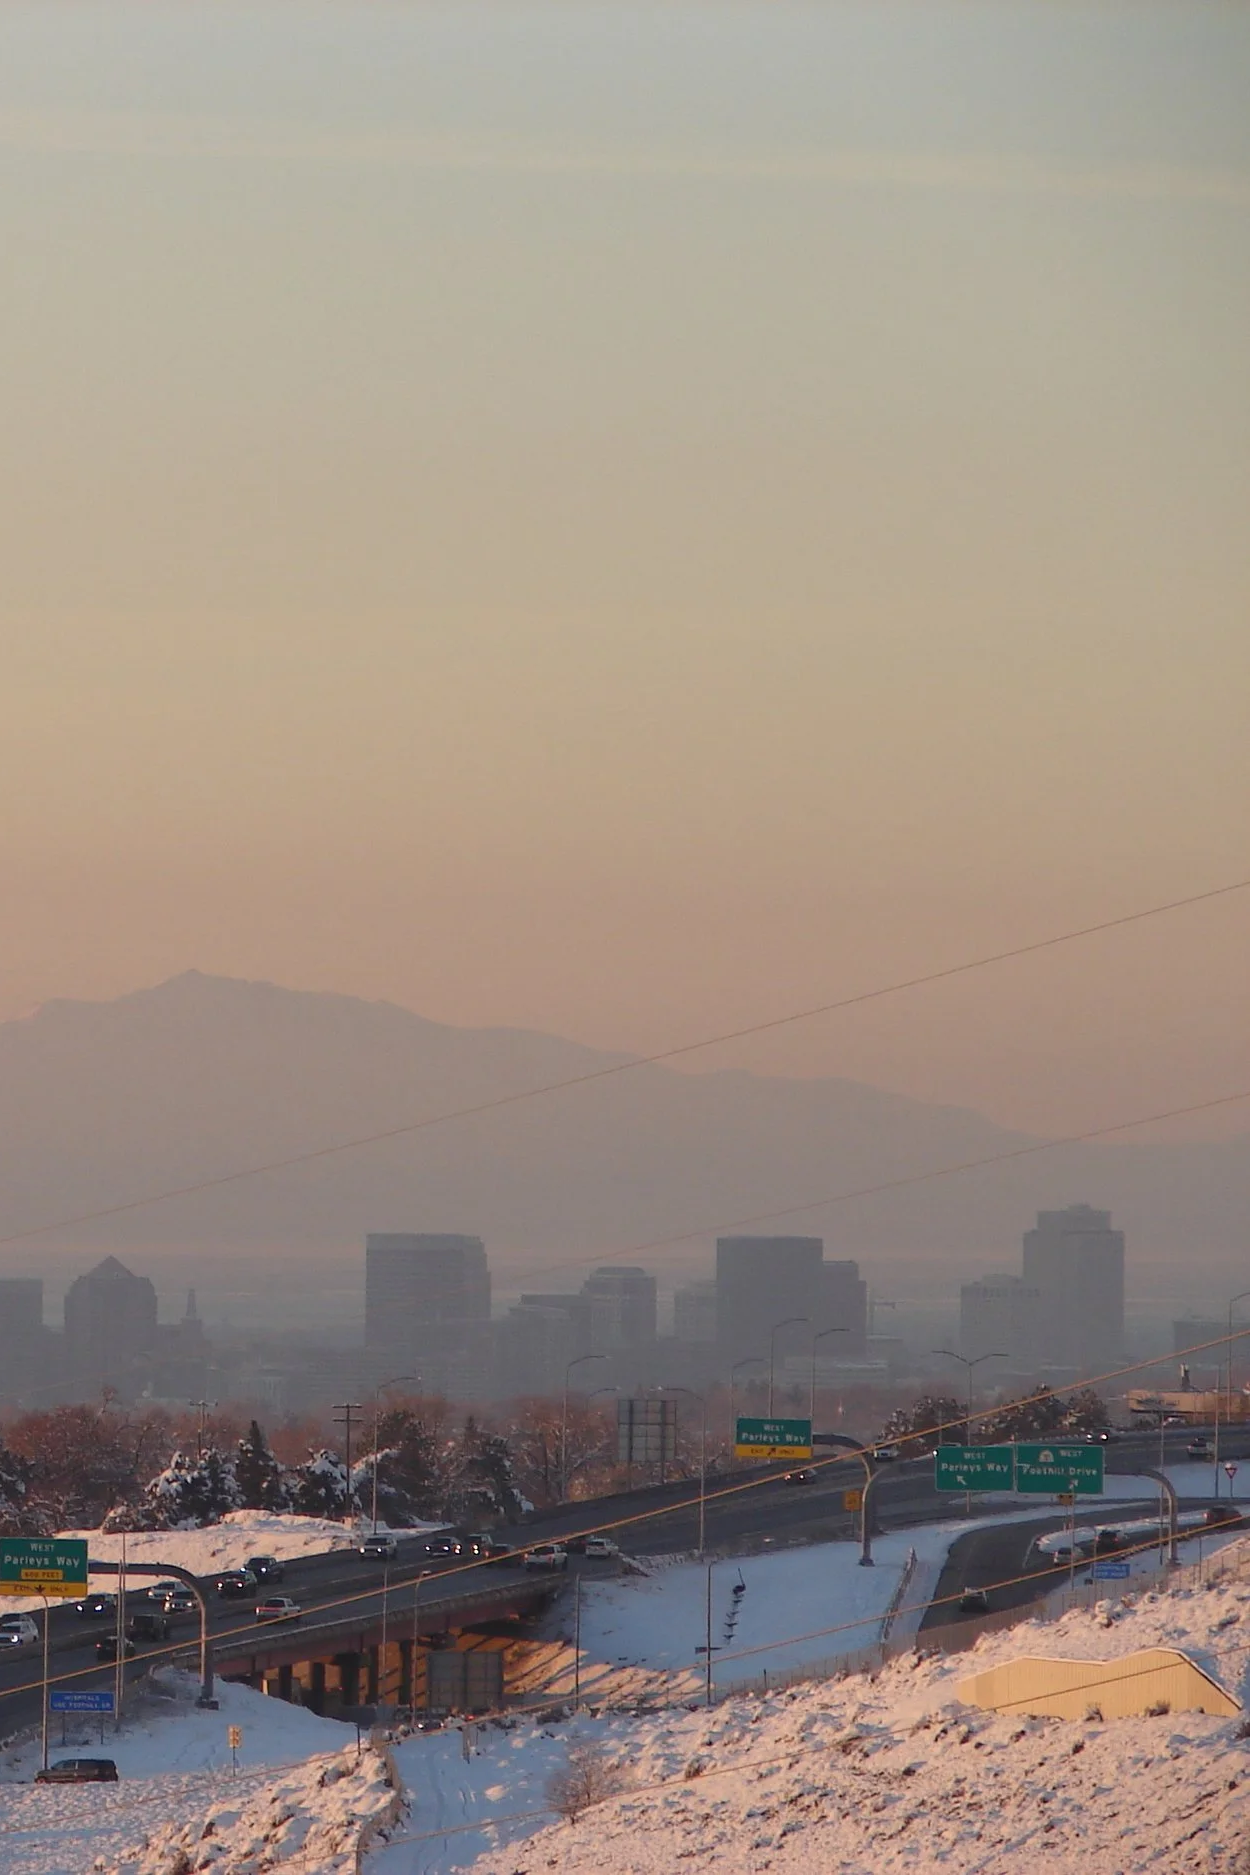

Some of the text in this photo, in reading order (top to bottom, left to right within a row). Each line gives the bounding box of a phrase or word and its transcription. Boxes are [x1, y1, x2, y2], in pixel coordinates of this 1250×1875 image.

[742, 1432, 806, 1444] Parleys Way
[941, 1463, 1008, 1474] Parleys Way
[1069, 1466, 1098, 1476] Drive
[30, 1543, 54, 1552] WEST
[4, 1555, 80, 1568] Parleys Way
